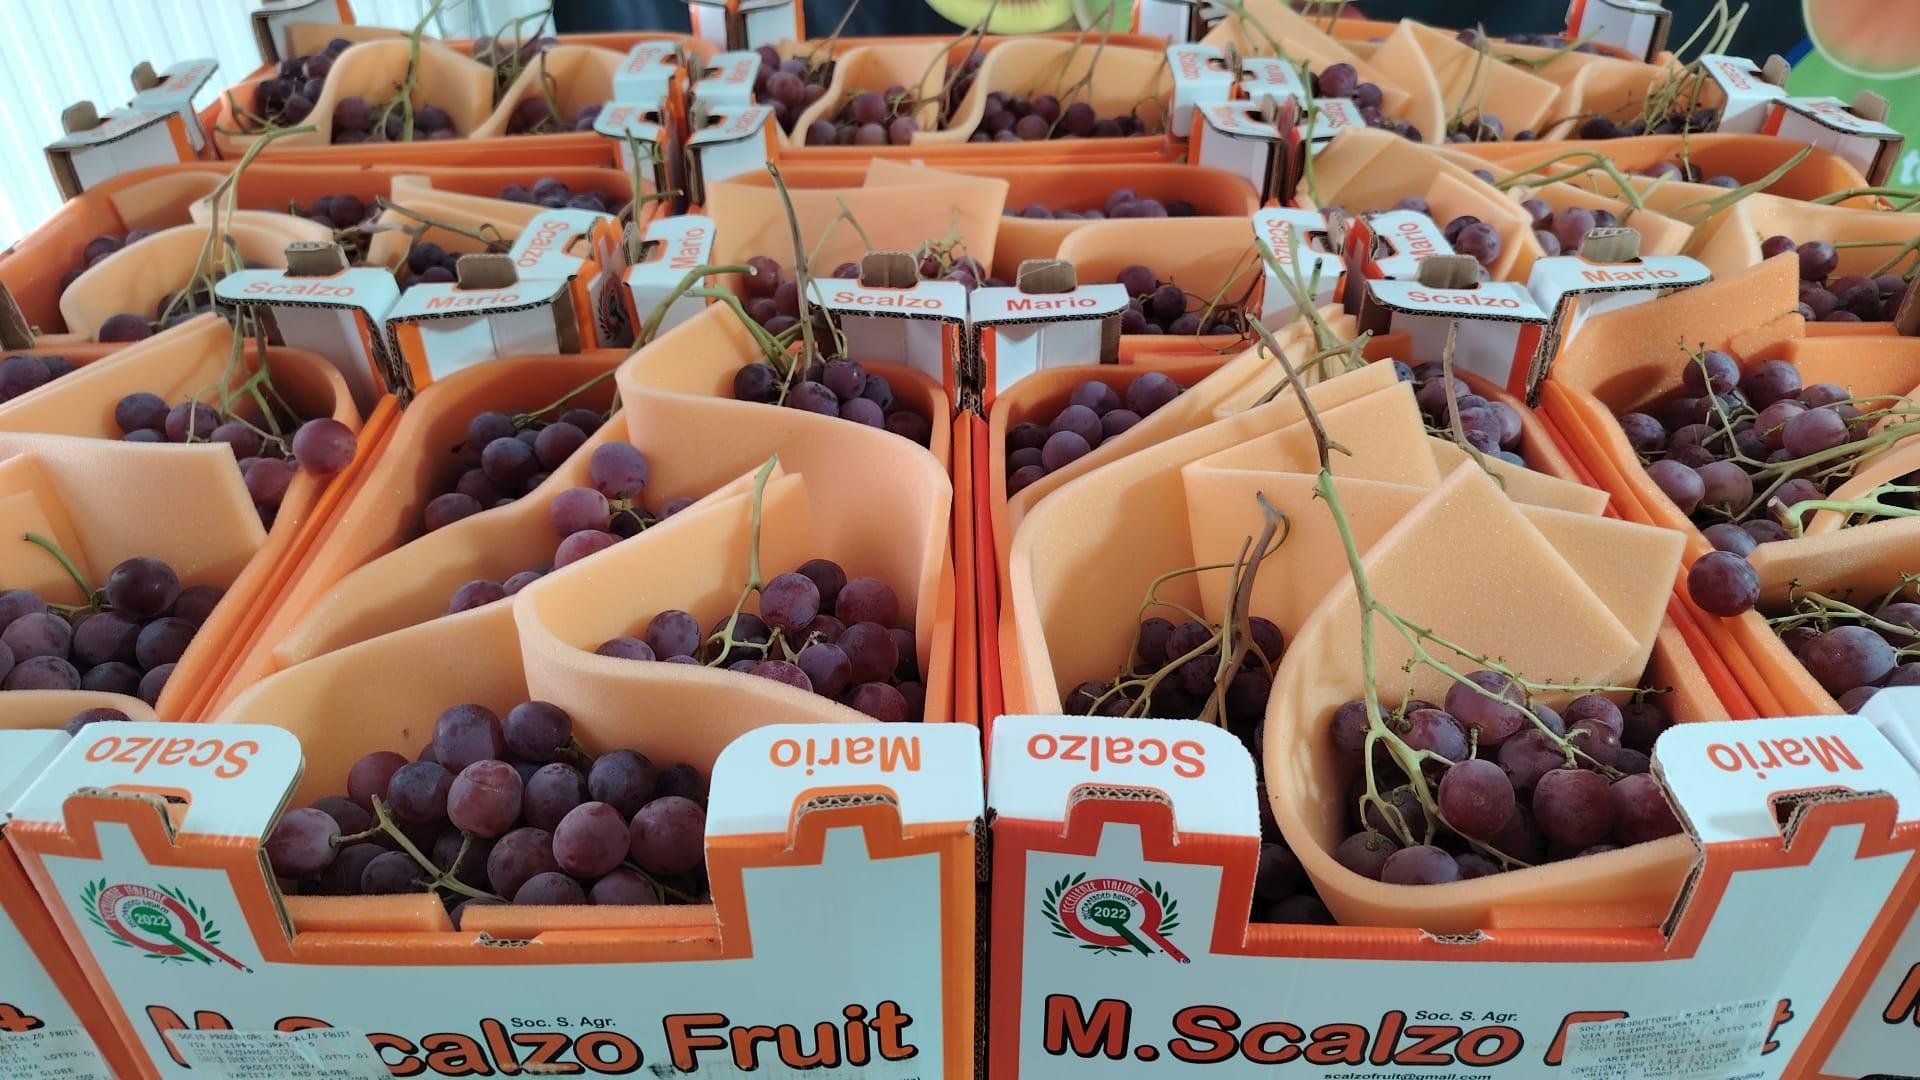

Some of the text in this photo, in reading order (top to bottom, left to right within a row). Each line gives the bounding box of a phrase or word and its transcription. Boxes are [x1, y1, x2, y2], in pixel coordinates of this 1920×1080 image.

[517, 222, 570, 268] Scalzo
[669, 228, 705, 270] Mario
[1266, 219, 1292, 265] Scalzo
[1581, 264, 1679, 284] Mario
[243, 280, 356, 299] Scalzo
[833, 289, 943, 310] Scalzo
[1407, 290, 1520, 309] Scalzo
[426, 292, 520, 311] Mario
[1006, 294, 1097, 312] Mario
[85, 736, 260, 780] Scalzo
[769, 736, 921, 777] Mario
[1026, 733, 1206, 778] Scalzo
[1706, 734, 1864, 780] Mario
[134, 912, 169, 926] 2022
[1094, 907, 1127, 920] 2022
[511, 1016, 617, 1030] Soc. S. Agr.
[1415, 1010, 1518, 1023] Soc. S. Agr.
[663, 1000, 918, 1073] Fruit
